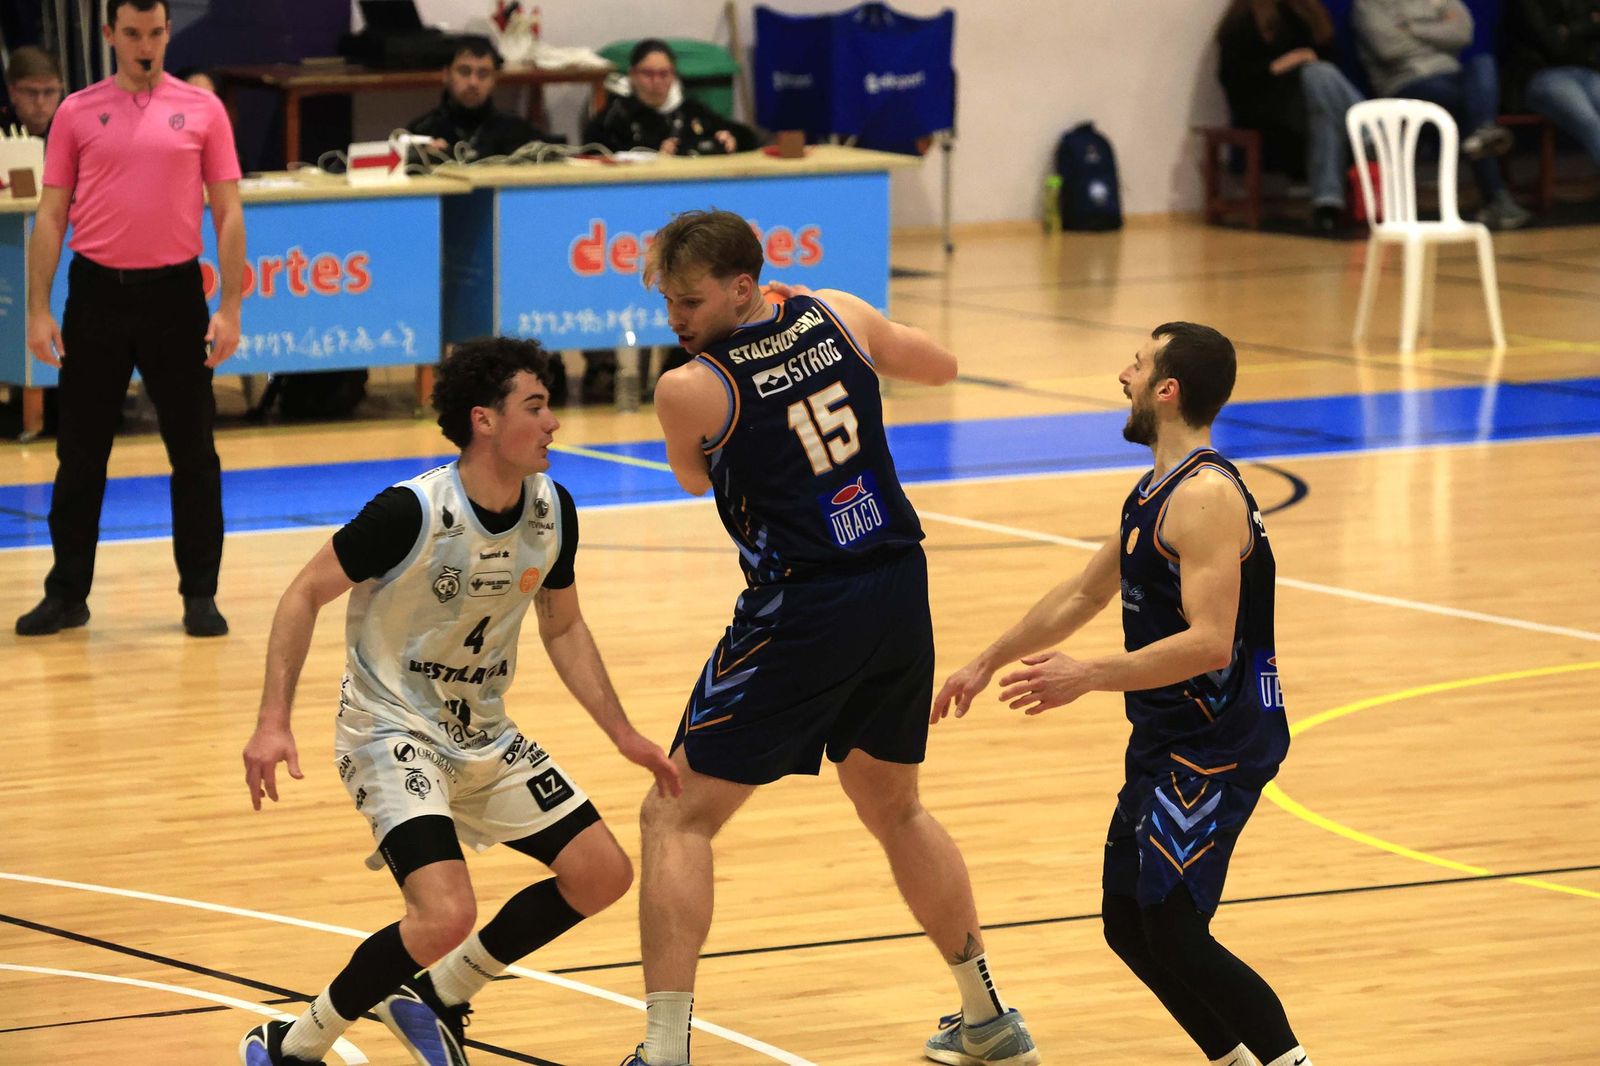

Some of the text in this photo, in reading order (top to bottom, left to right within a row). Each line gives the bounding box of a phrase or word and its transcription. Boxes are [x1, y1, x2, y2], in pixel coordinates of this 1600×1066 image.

[787, 338, 843, 382] STROG
[787, 380, 861, 477] 15
[831, 497, 883, 546] UBAGO
[463, 616, 491, 655] 4
[535, 774, 563, 799] LZ
